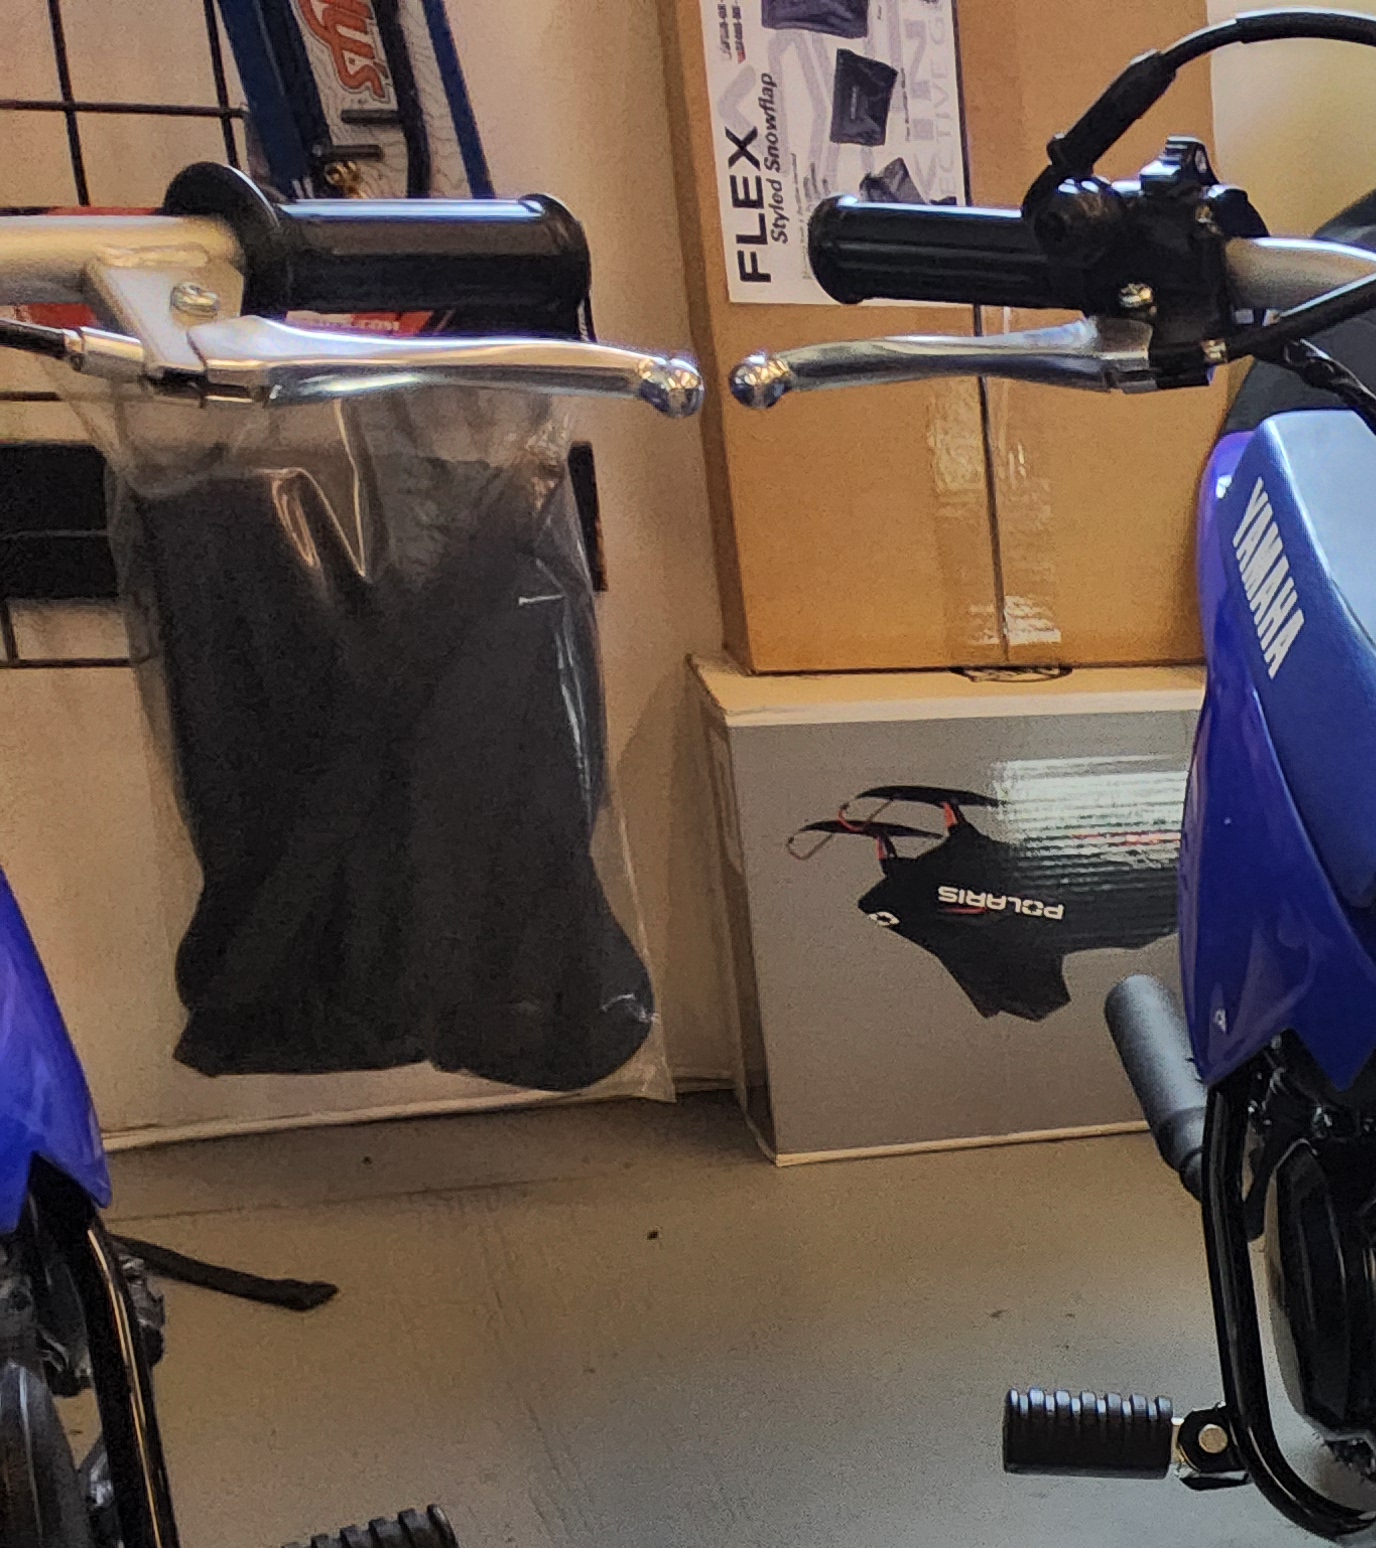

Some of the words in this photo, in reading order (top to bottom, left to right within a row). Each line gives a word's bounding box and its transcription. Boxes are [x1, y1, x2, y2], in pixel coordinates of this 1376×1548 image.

[758, 72, 780, 173] Snowflap
[724, 126, 771, 283] FLEX
[766, 178, 789, 245] Styled
[1232, 476, 1305, 680] YAMAHA
[938, 885, 1065, 920] POLARIS
